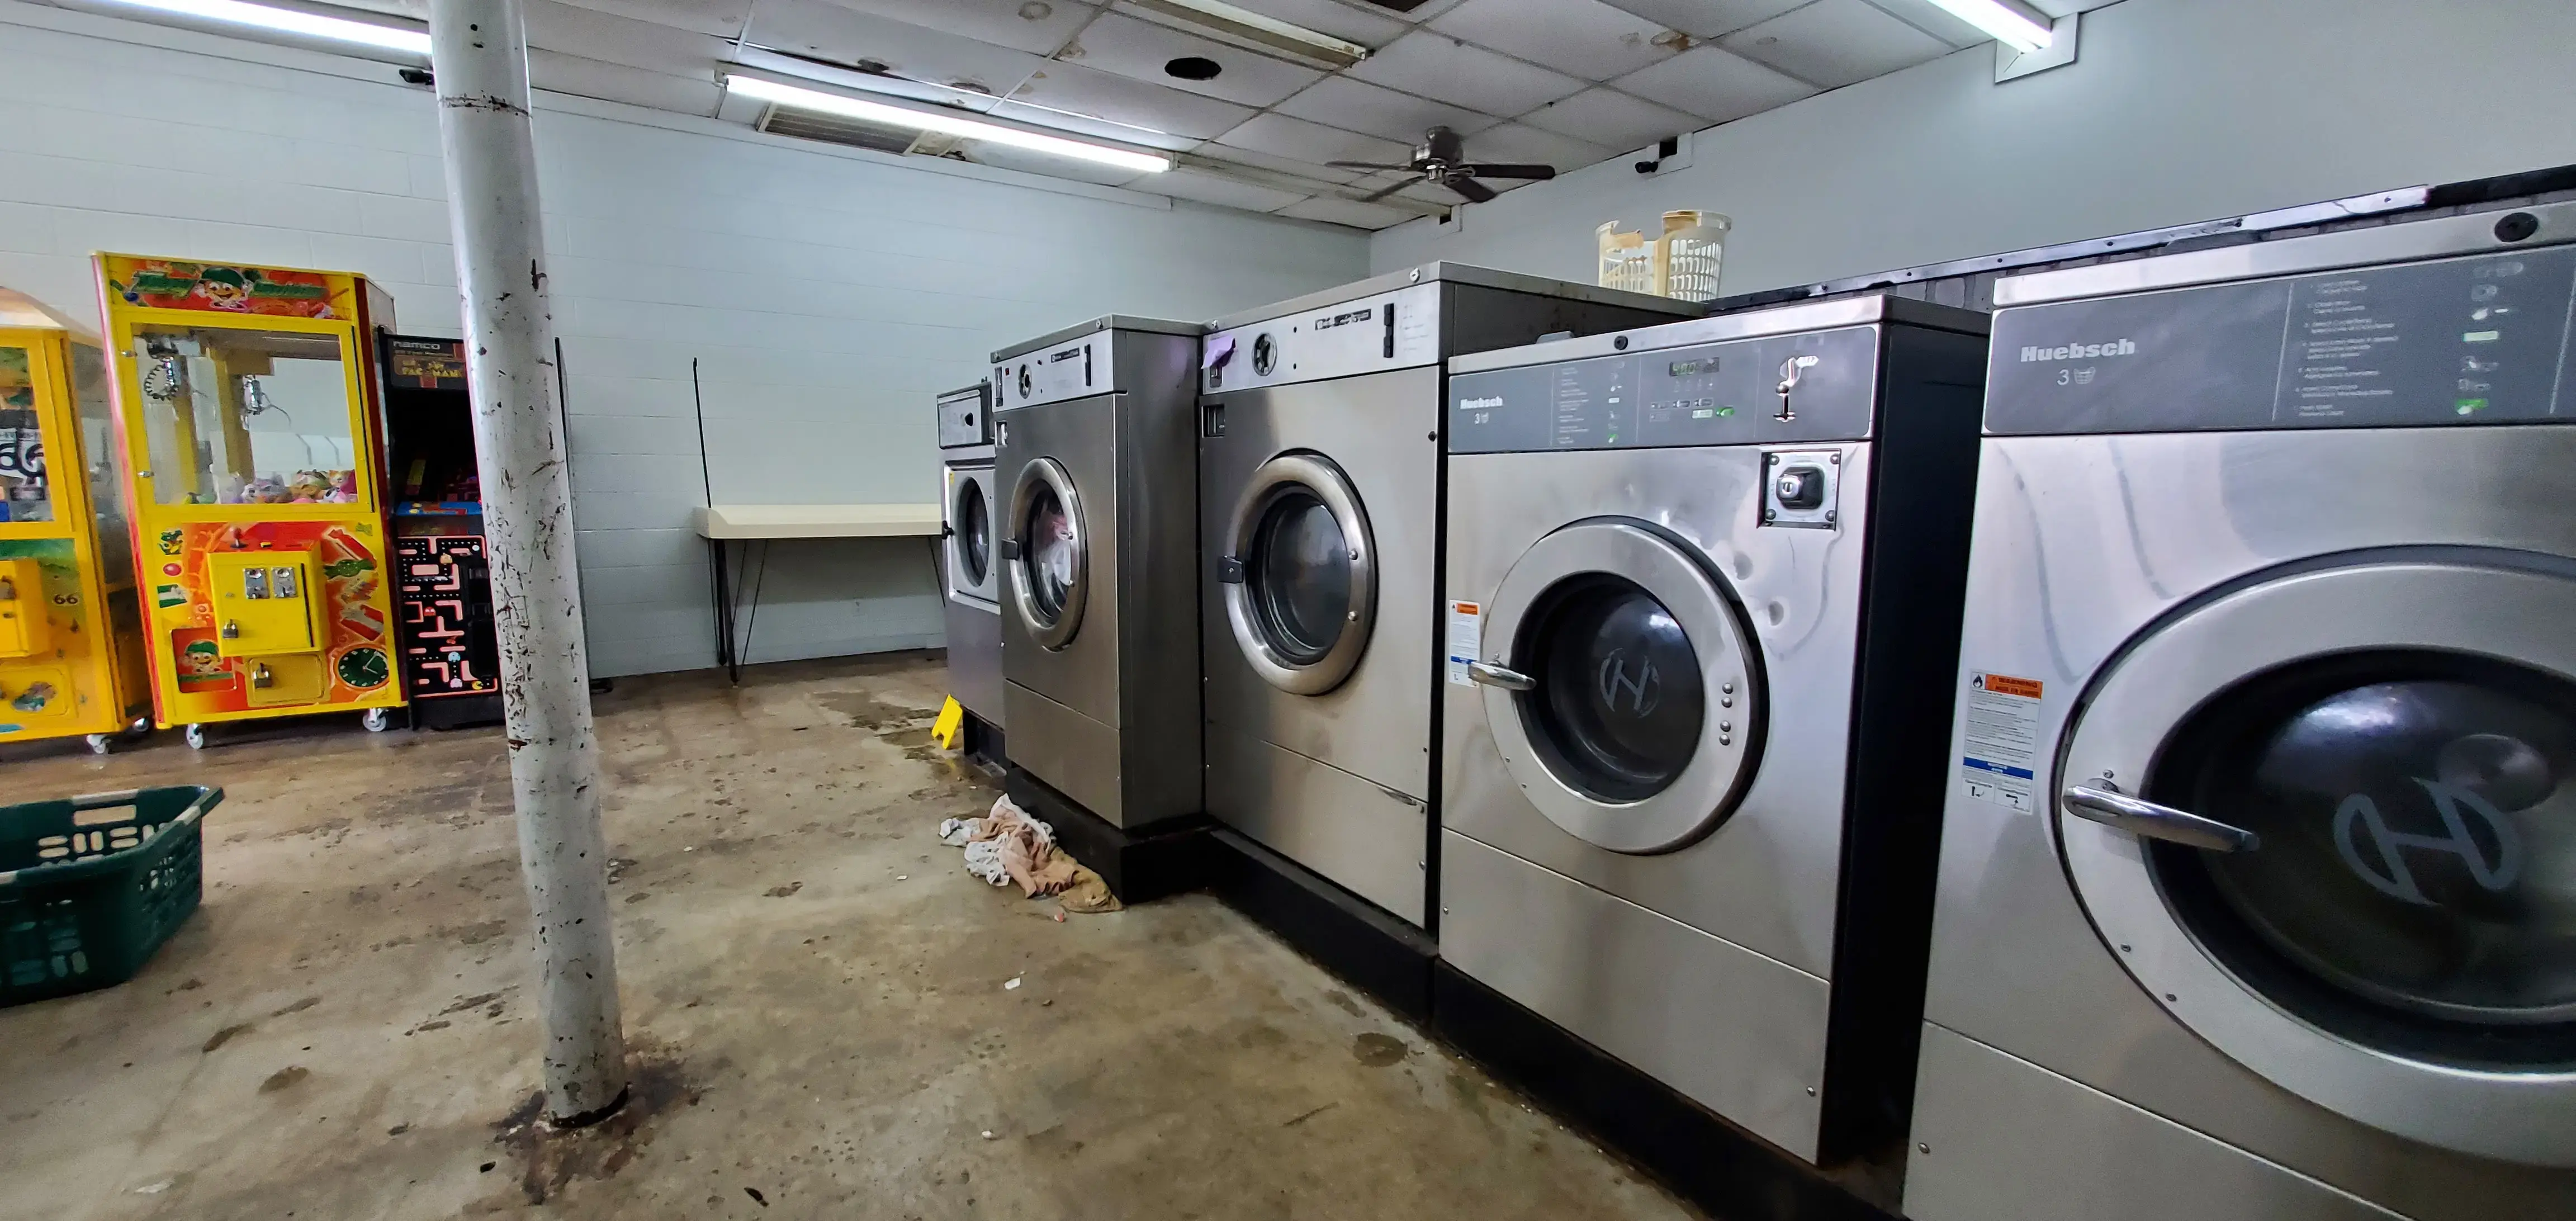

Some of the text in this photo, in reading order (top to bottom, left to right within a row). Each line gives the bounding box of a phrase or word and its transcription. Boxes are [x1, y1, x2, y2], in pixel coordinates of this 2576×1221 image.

[393, 341, 441, 349] namco
[2020, 339, 2135, 362] Huebsch
[2057, 369, 2069, 386] 3
[1460, 395, 1503, 410] Huebsch
[54, 594, 78, 604] 66
